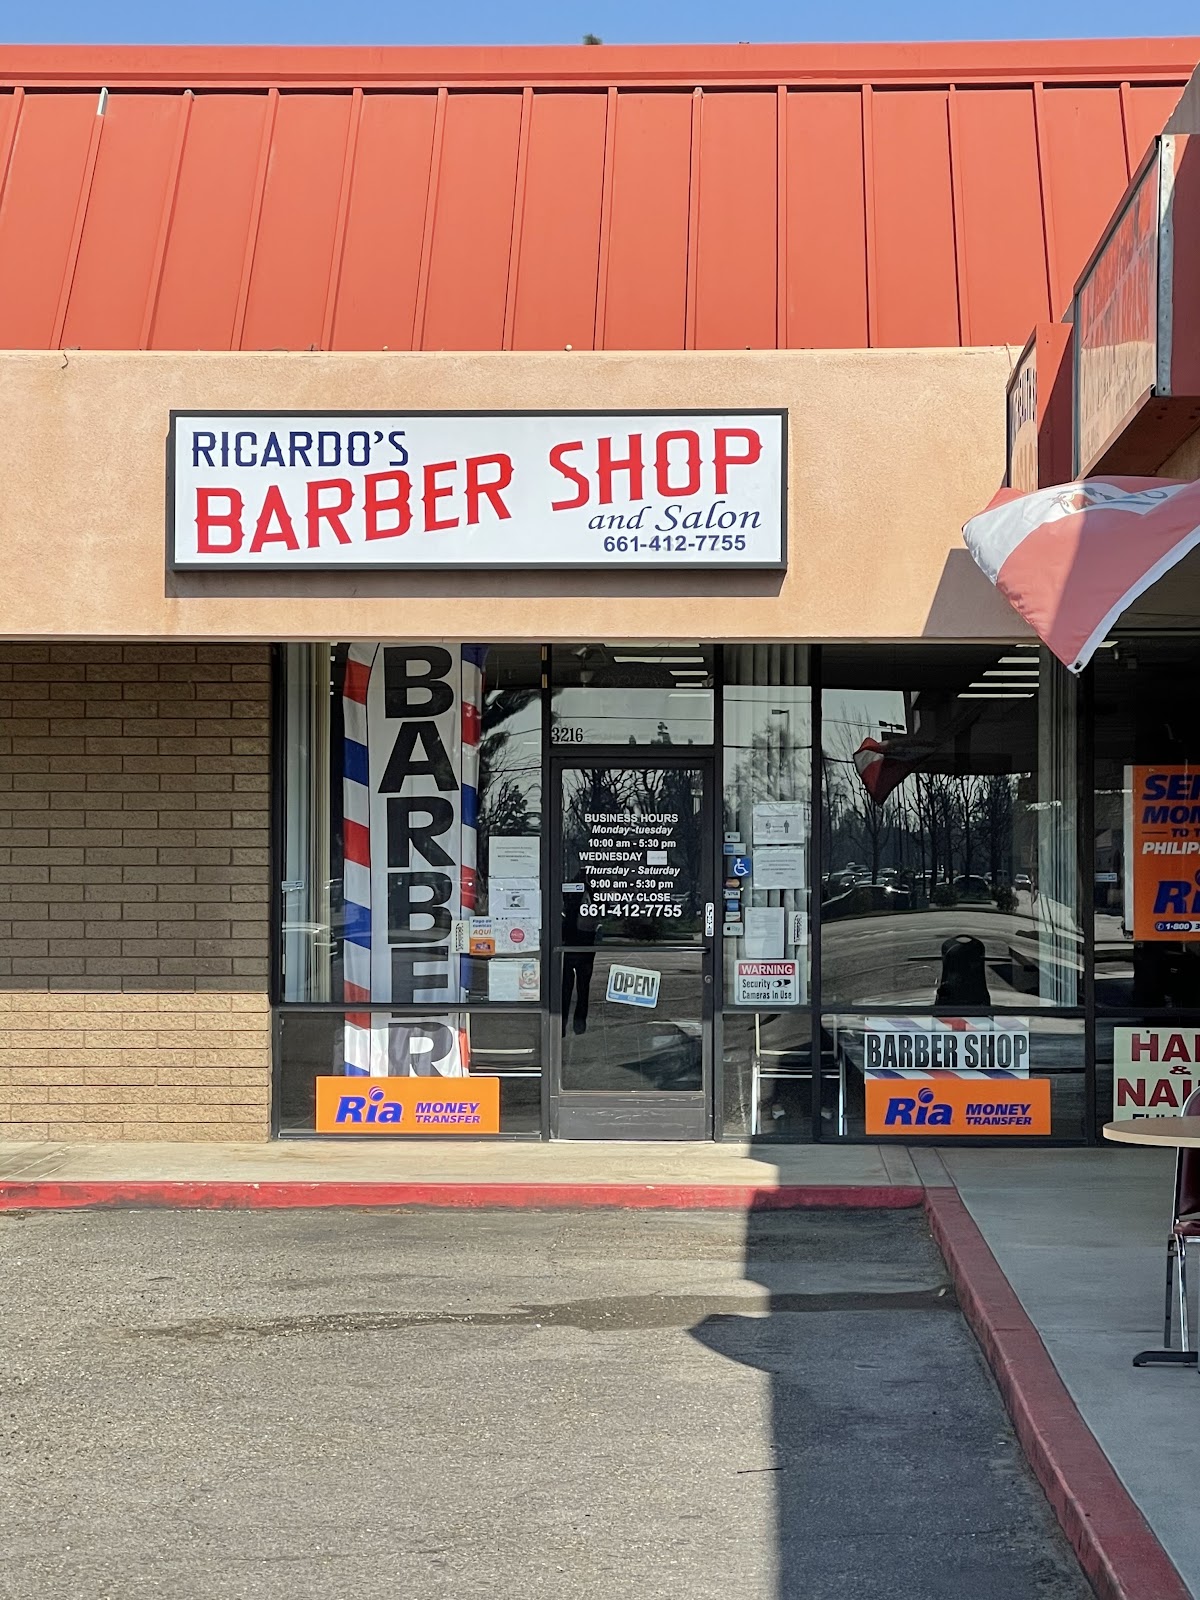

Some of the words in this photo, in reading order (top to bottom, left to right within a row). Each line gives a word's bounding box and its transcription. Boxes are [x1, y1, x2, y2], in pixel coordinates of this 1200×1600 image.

[194, 452, 515, 554] BARBER
[549, 427, 764, 512] SHOP
[587, 505, 653, 530] and
[654, 500, 763, 532] Salon
[603, 534, 747, 553] 661-412-7755
[551, 727, 584, 743] 3216
[584, 813, 639, 823] BUSINESS
[640, 813, 679, 823] HOURS
[591, 825, 630, 836] Monday
[1171, 828, 1189, 837] TO
[588, 838, 614, 848] 10:00
[615, 840, 631, 848] am
[638, 838, 659, 848] 5:30
[660, 840, 677, 850] pm
[1142, 841, 1200, 855] PHILIP
[378, 644, 460, 1078] BARBER
[578, 851, 643, 861] WEDNESDAY
[584, 865, 630, 877] Thursday
[637, 865, 681, 877] Saturday
[589, 879, 611, 889] 9:00
[612, 881, 628, 889] am
[635, 879, 656, 889] 5:30
[657, 881, 674, 891] pm
[592, 892, 634, 902] SUNDAY
[636, 892, 671, 902] CLOSE
[579, 903, 683, 918] 661-412-7755
[1165, 922, 1190, 931] 1-800
[741, 964, 793, 975] WARNING
[613, 971, 656, 998] OPEN
[742, 979, 771, 990] Security
[742, 990, 770, 1000] Cameras
[772, 990, 779, 999] In
[780, 990, 792, 1000] Use
[866, 1034, 958, 1068] BARBER
[964, 1033, 1028, 1069] SHOP
[1131, 1033, 1200, 1063] HA
[1169, 1065, 1192, 1075] &
[335, 1085, 403, 1123] Ria
[415, 1102, 481, 1114] MONEY
[884, 1087, 953, 1126] Ria
[965, 1103, 1032, 1116] MONEY
[415, 1115, 481, 1124] TRANSFER
[966, 1116, 1032, 1126] TRANSFER
